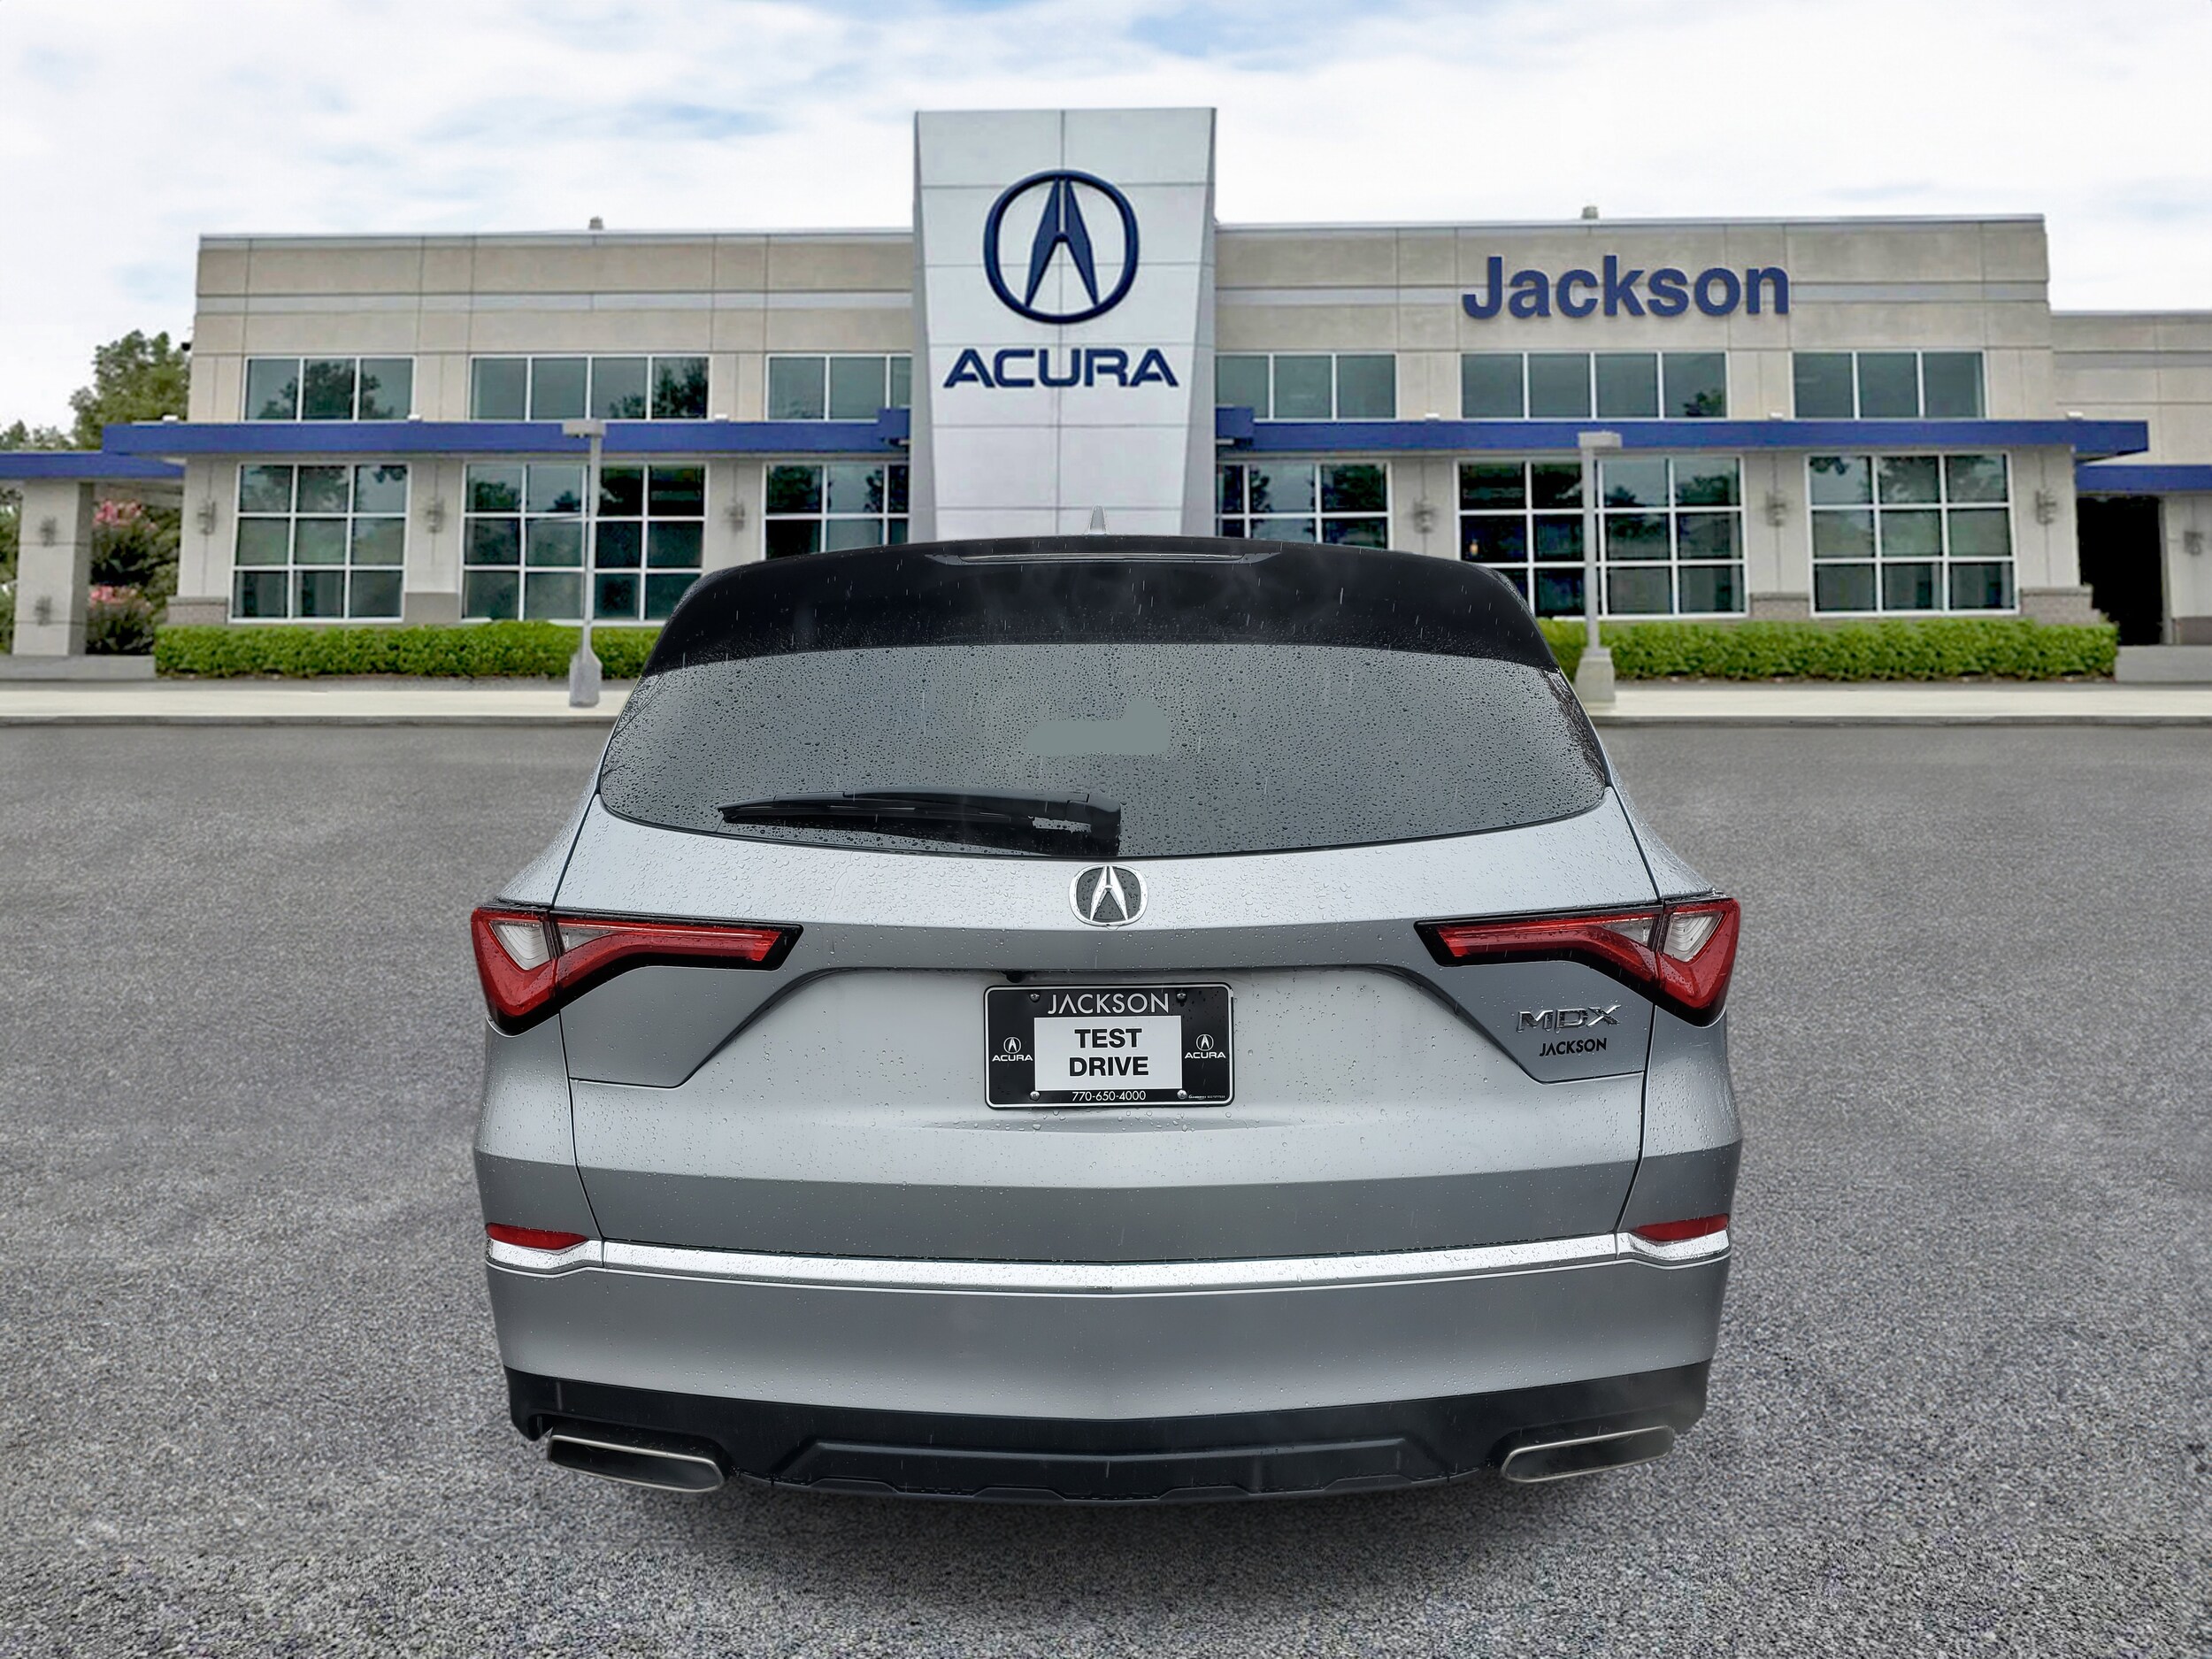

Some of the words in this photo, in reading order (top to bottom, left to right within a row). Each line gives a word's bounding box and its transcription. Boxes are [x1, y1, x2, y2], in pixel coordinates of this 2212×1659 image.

[1463, 255, 1789, 319] Jackson
[943, 349, 1179, 388] ACURA
[1048, 993, 1170, 1014] JACKSON
[1517, 1004, 1621, 1032] MDX
[1074, 1028, 1142, 1048] TEST
[1539, 1038, 1607, 1056] JACKSON
[1069, 1056, 1148, 1077] DRIVE
[1071, 1091, 1147, 1102] 770-650-4000
